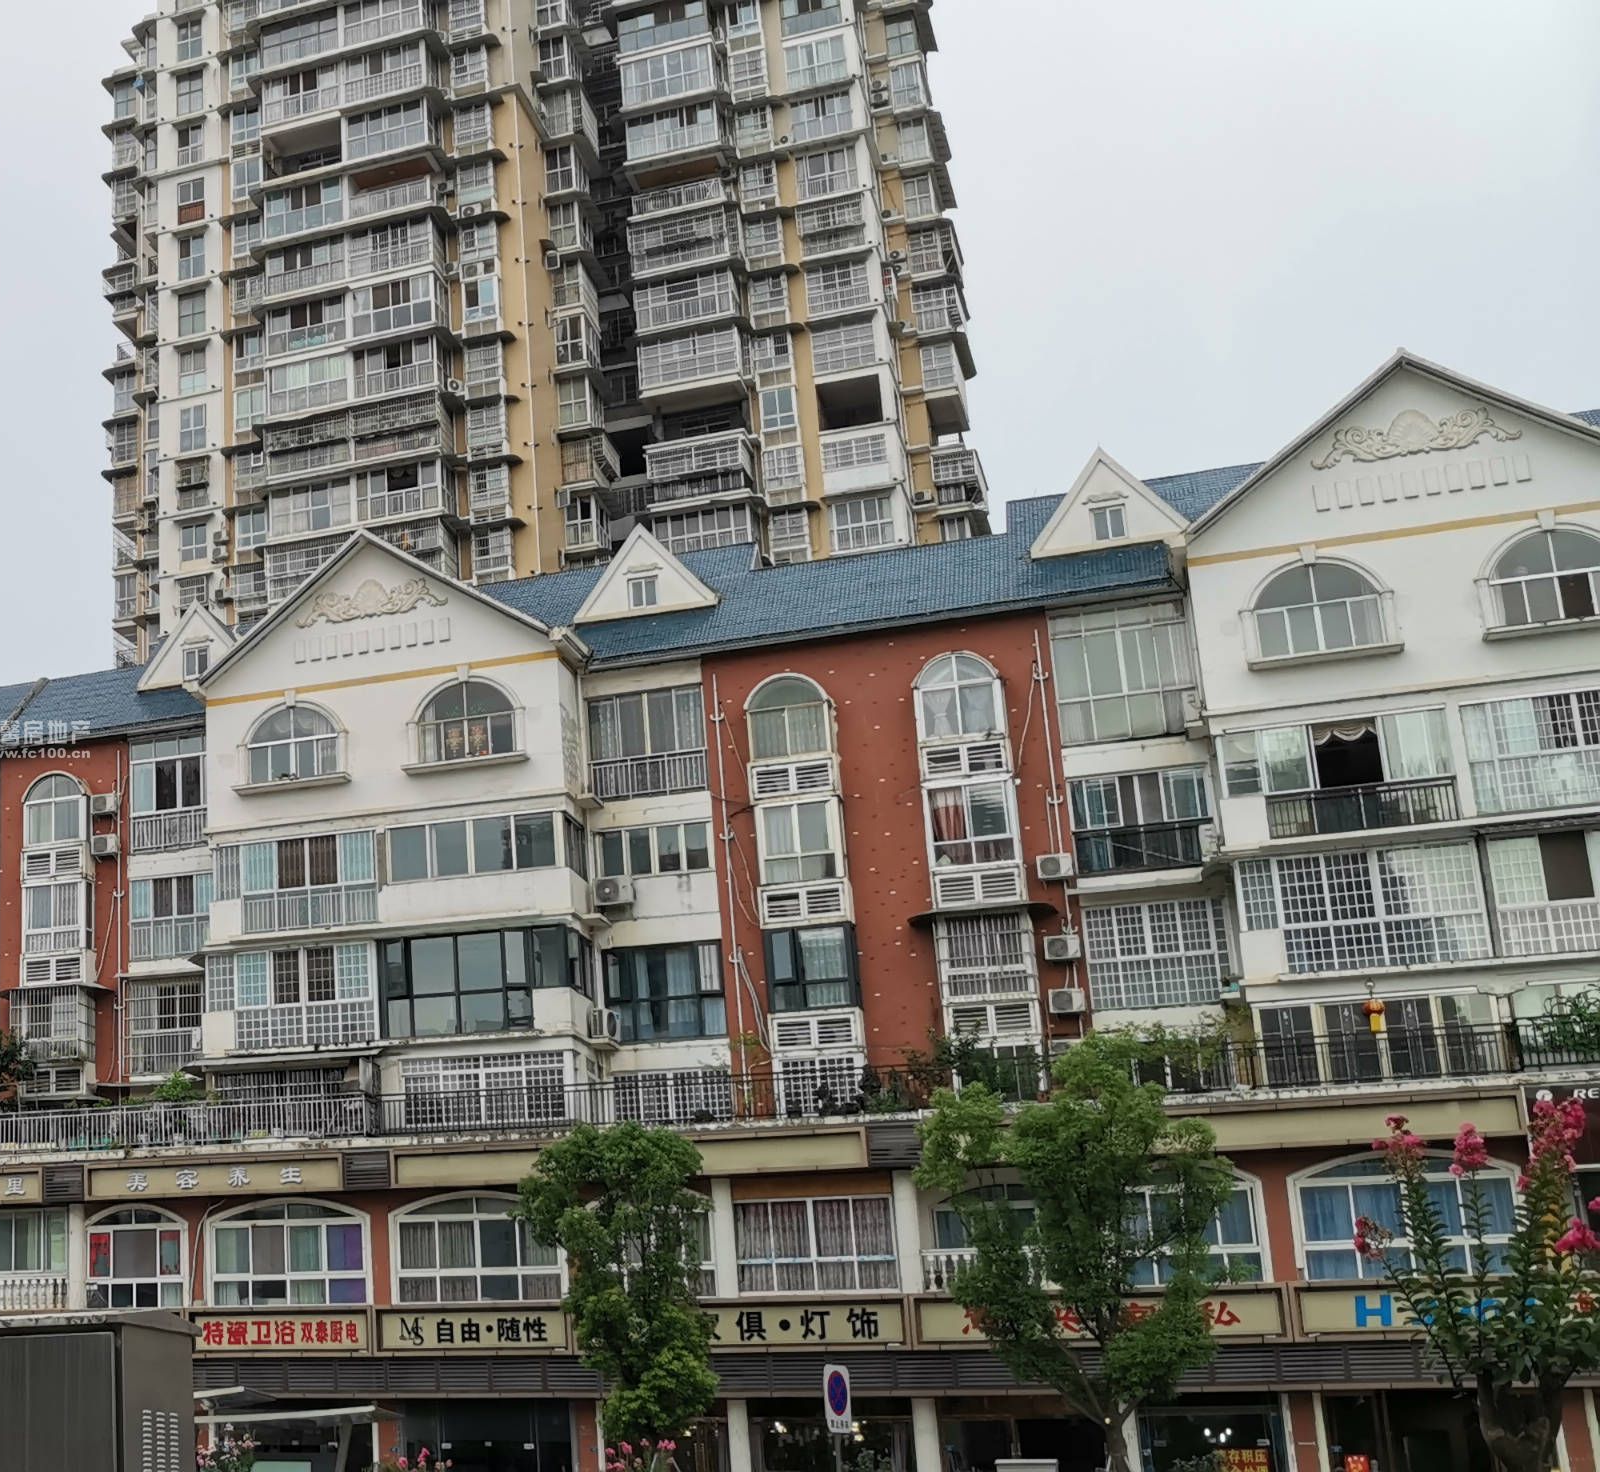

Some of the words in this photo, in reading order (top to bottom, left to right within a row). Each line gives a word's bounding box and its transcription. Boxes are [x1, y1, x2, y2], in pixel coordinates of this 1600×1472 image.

[126, 1166, 303, 1192] 美容养生
[202, 1320, 296, 1346] 特瓷卫浴
[300, 1319, 359, 1344] 双泰厨电
